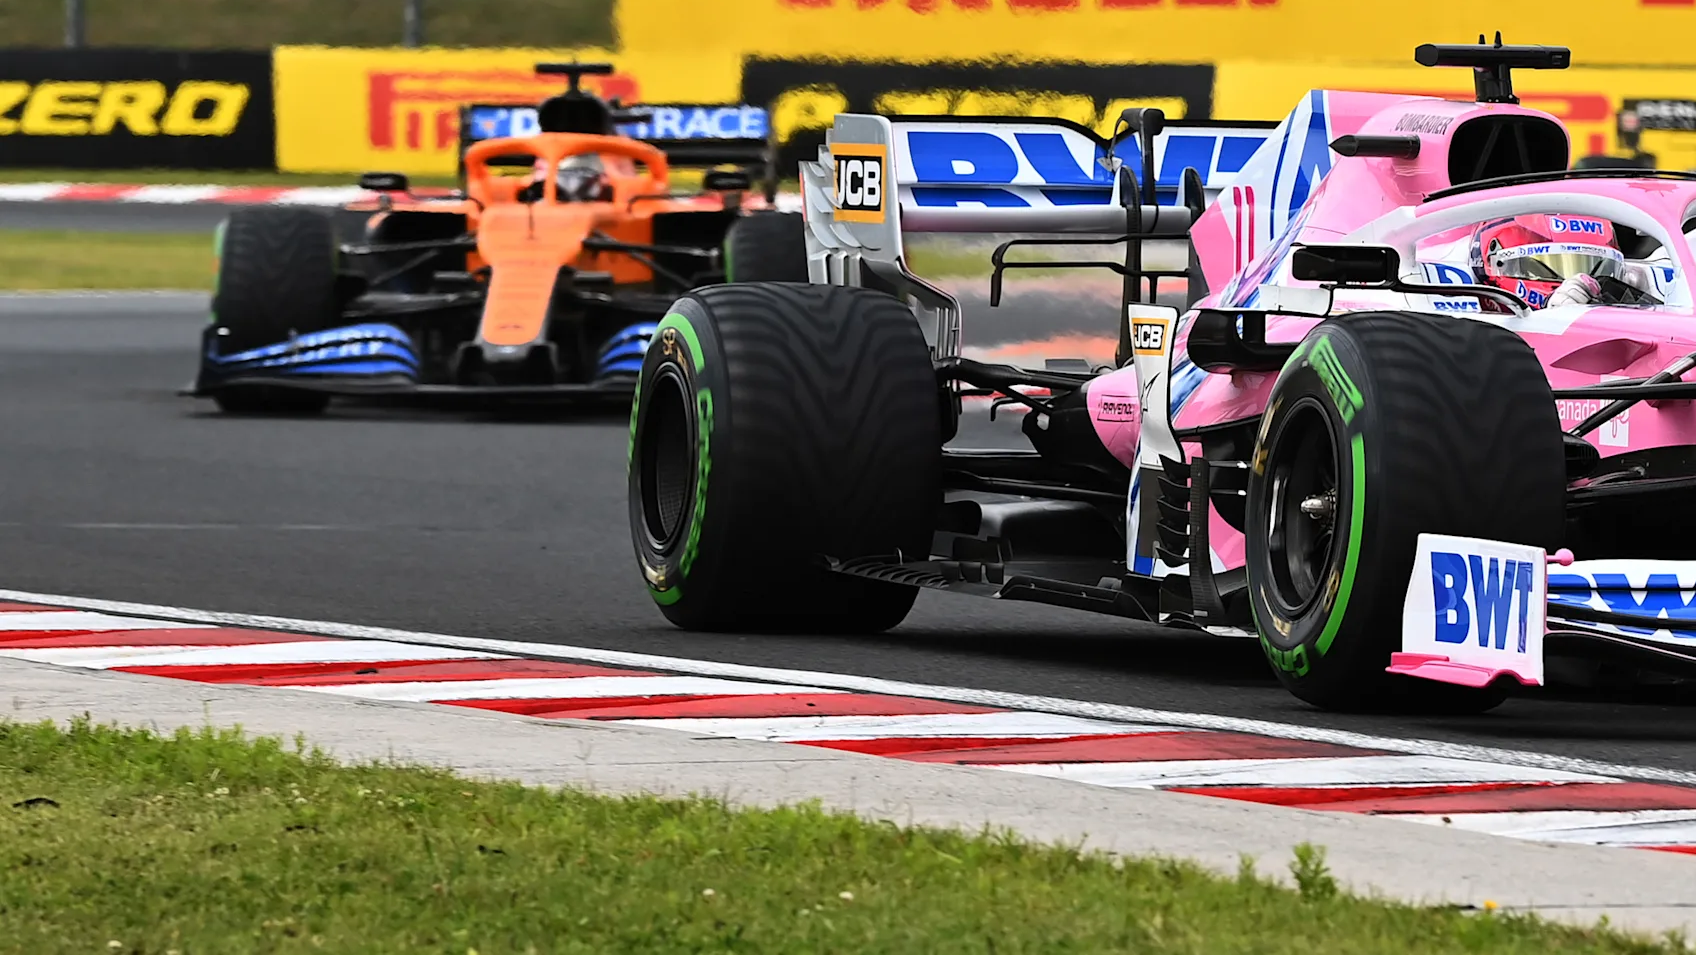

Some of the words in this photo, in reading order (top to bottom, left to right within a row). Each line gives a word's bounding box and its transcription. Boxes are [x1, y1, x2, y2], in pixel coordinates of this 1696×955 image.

[835, 158, 881, 209] JCB
[1568, 219, 1605, 235] BWT
[1527, 246, 1551, 255] BWT
[1134, 325, 1163, 349] JCB
[1431, 551, 1533, 653] BWT
